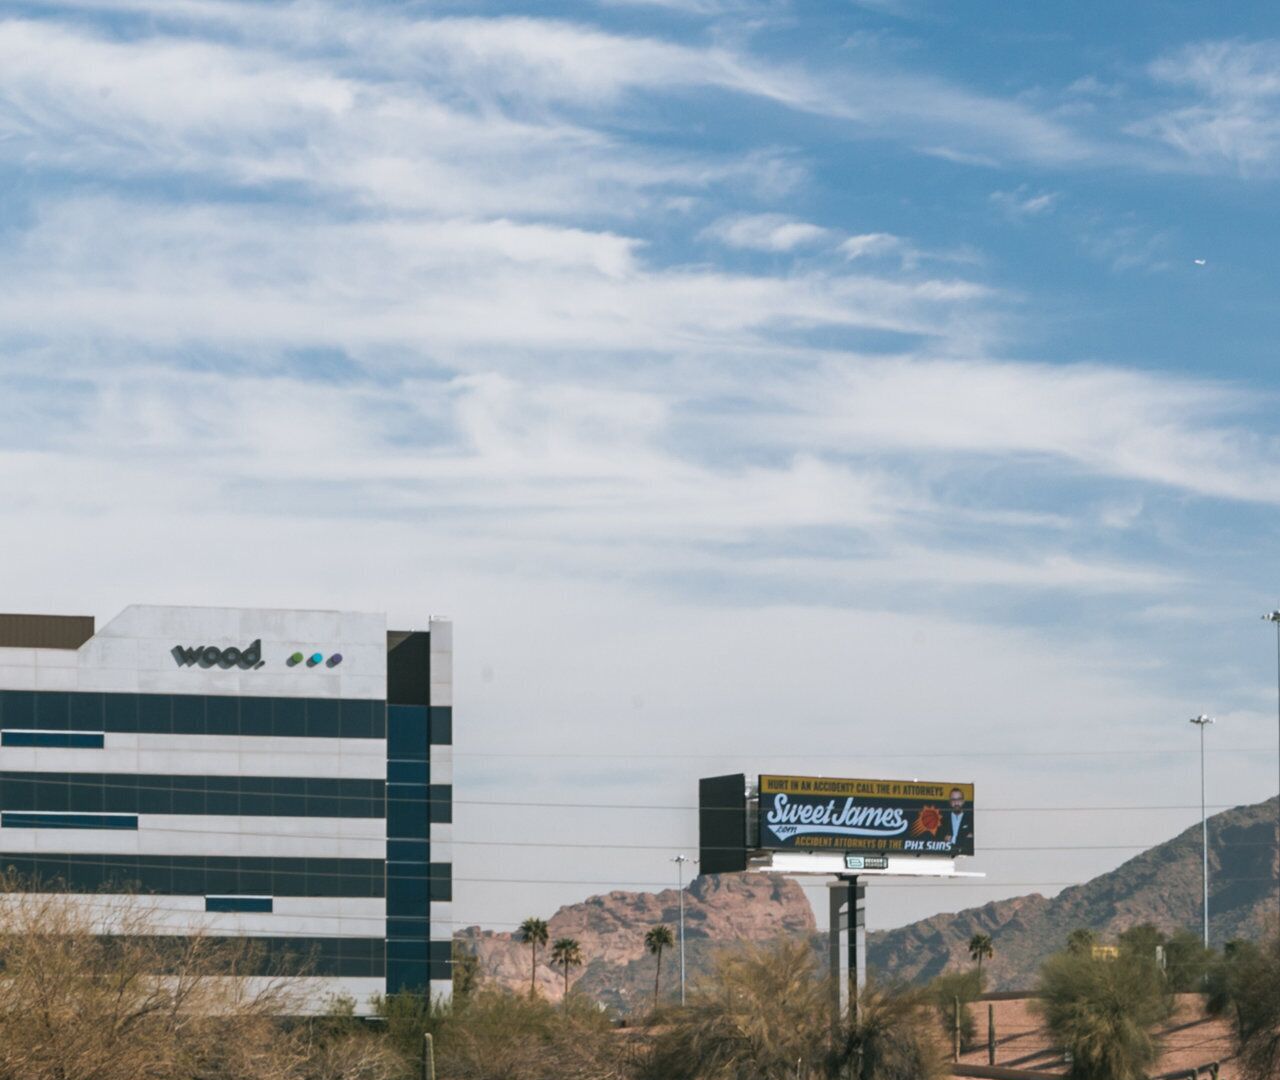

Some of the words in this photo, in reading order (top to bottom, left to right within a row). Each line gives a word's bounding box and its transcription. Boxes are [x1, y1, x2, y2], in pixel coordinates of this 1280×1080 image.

[768, 779, 788, 790] HURT
[791, 781, 799, 791] IN
[801, 781, 811, 792] AN
[814, 782, 854, 794] ACCIDENT?
[856, 784, 875, 794] CALL
[876, 785, 890, 795] THE
[903, 786, 944, 796] ATTORNEYS
[795, 837, 832, 847] ACCIDENT
[834, 838, 876, 849] ATTORNEYS
[878, 839, 886, 849] OF
[889, 839, 902, 849] THE
[904, 840, 924, 850] PHX
